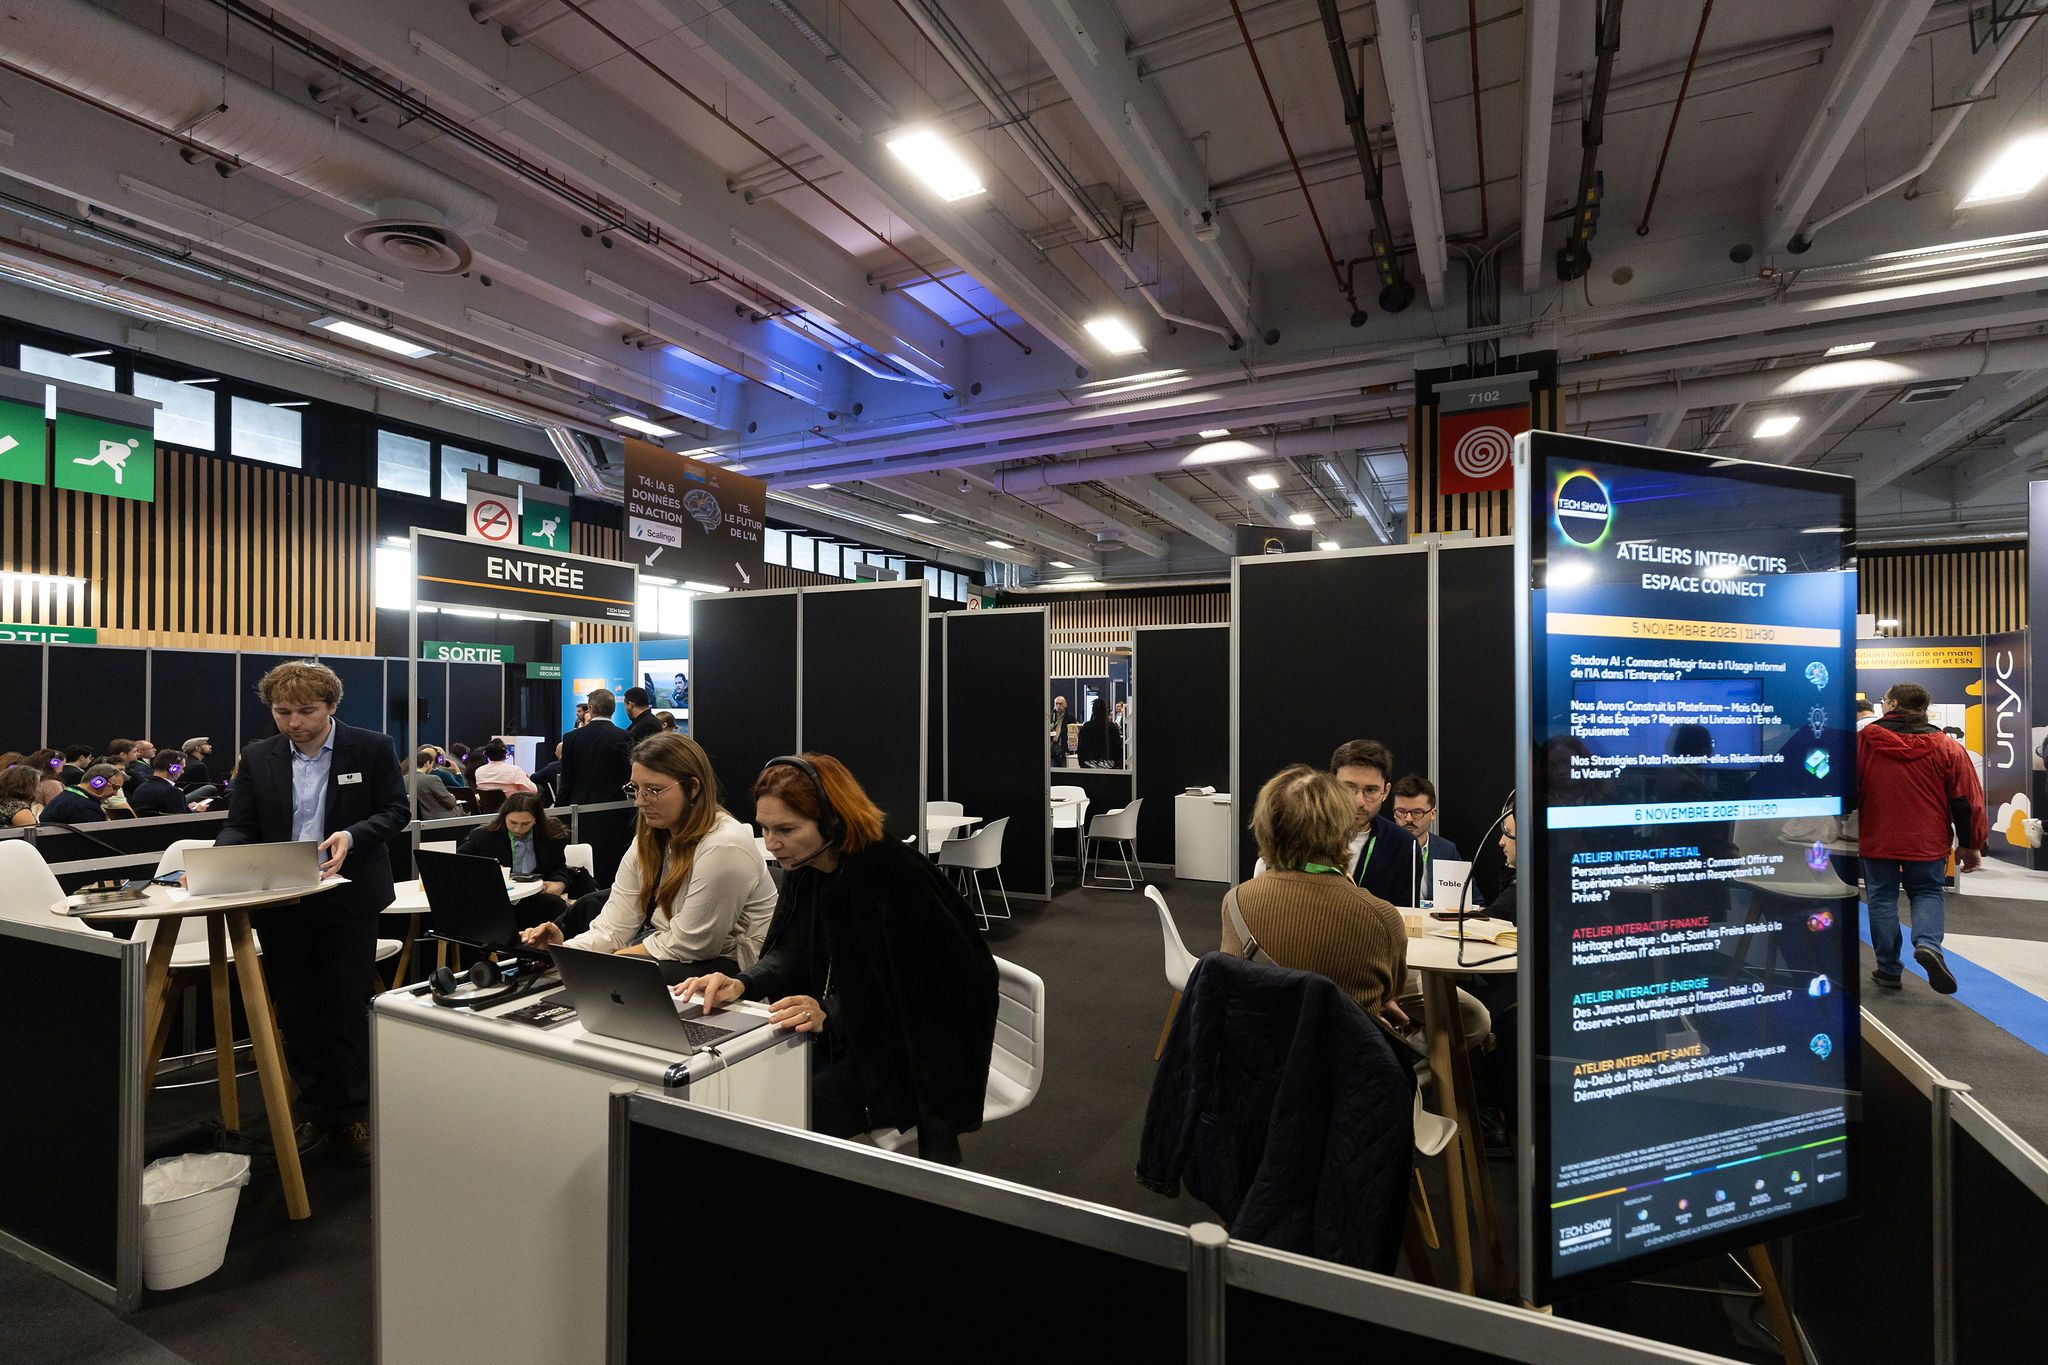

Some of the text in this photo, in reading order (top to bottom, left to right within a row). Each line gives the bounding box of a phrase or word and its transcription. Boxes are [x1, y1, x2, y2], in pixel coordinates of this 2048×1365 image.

[1469, 391, 1500, 403] 7102
[639, 476, 675, 493] T4: IA &
[632, 489, 681, 509] DONNÉES
[739, 504, 750, 514] T5:
[1559, 498, 1607, 512] TECH SHOW
[629, 503, 682, 523] EN ACTION
[725, 514, 762, 530] LE FUTUR
[647, 529, 675, 542] Scalingo
[731, 528, 757, 542] DE L'IA
[1616, 544, 1787, 573] ATELIERS INTERACTIFS
[487, 556, 584, 590] ENTRÉE
[1642, 573, 1765, 597] ESPACE CONNECT
[1632, 622, 1775, 640] 5 NOVEMBRE 2025 11H30
[438, 646, 501, 662] SORTIE
[1570, 654, 1786, 674] Shadow AI Comment Réagir face à l'Usage Informel
[1570, 668, 1584, 678] de
[1601, 669, 1623, 680] dans
[1625, 670, 1674, 682] l'Entreprise
[1571, 700, 1774, 713] Nous Avons Construit la Plateforme Mais Qu'en
[1996, 651, 2021, 768] unyc
[1571, 714, 1595, 724] Est-il
[1597, 714, 1614, 725] des
[1615, 711, 1650, 727] Équipes
[1659, 714, 1699, 727] Repenser
[1700, 714, 1709, 725] la
[1709, 714, 1745, 725] Livraison
[1746, 714, 1752, 725] à
[1771, 715, 1782, 725] de
[1571, 753, 1784, 769] Nos Stratégies Data Produisent-elles Réellement de
[1571, 768, 1613, 779] la Valeur
[1635, 803, 1777, 821] 6 NOVEMBRE 2025 11H30
[1571, 847, 1700, 864] ATELIER INTERACTIF RETAIL
[1571, 853, 1783, 878] Personnalisation Responsable Comment Offrir une
[1571, 866, 1775, 892] Expérience Sur-Mesure tout en Respectant la Vie
[1571, 891, 1603, 903] Privée
[1572, 915, 1710, 939] ATELIER INTERACTIF FINANCE
[1572, 938, 1613, 954] Héritage
[1614, 938, 1624, 949] et
[1625, 935, 1656, 950] Risque
[1661, 931, 1686, 944] Quels
[1687, 930, 1706, 942] Sont
[1707, 928, 1719, 939] les
[1719, 925, 1745, 938] Freins
[1745, 923, 1767, 935] Réels
[1774, 921, 1783, 932] la
[1572, 950, 1638, 966] Modernisation
[1648, 945, 1670, 957] dans
[1671, 945, 1680, 955] la
[1681, 941, 1713, 954] Finance
[1573, 977, 1709, 1005] ATELIER INTERACTIF ÉNERGIE
[1573, 1006, 1593, 1018] Des
[1594, 1001, 1635, 1015] Jumeaux
[1636, 994, 1688, 1011] Numériques
[1696, 988, 1729, 1003] l'Impact
[1730, 986, 1746, 998] Réel
[1752, 982, 1765, 993] Où
[1573, 992, 1785, 1031] Observe-t-on un Retour sur Investissement Concret
[1573, 1042, 1701, 1076] ATELIER INTERACTIF SANTÉ
[1573, 1043, 1786, 1090] Au-Delà du Pilote Quelles Solutions Numériques se
[1573, 1064, 1738, 1102] Démarquent Réellement dans la Santé
[1559, 1225, 1584, 1240] TECH
[1583, 1217, 1612, 1234] SHOW
[1560, 1237, 1611, 1256] techshowparis.fr
